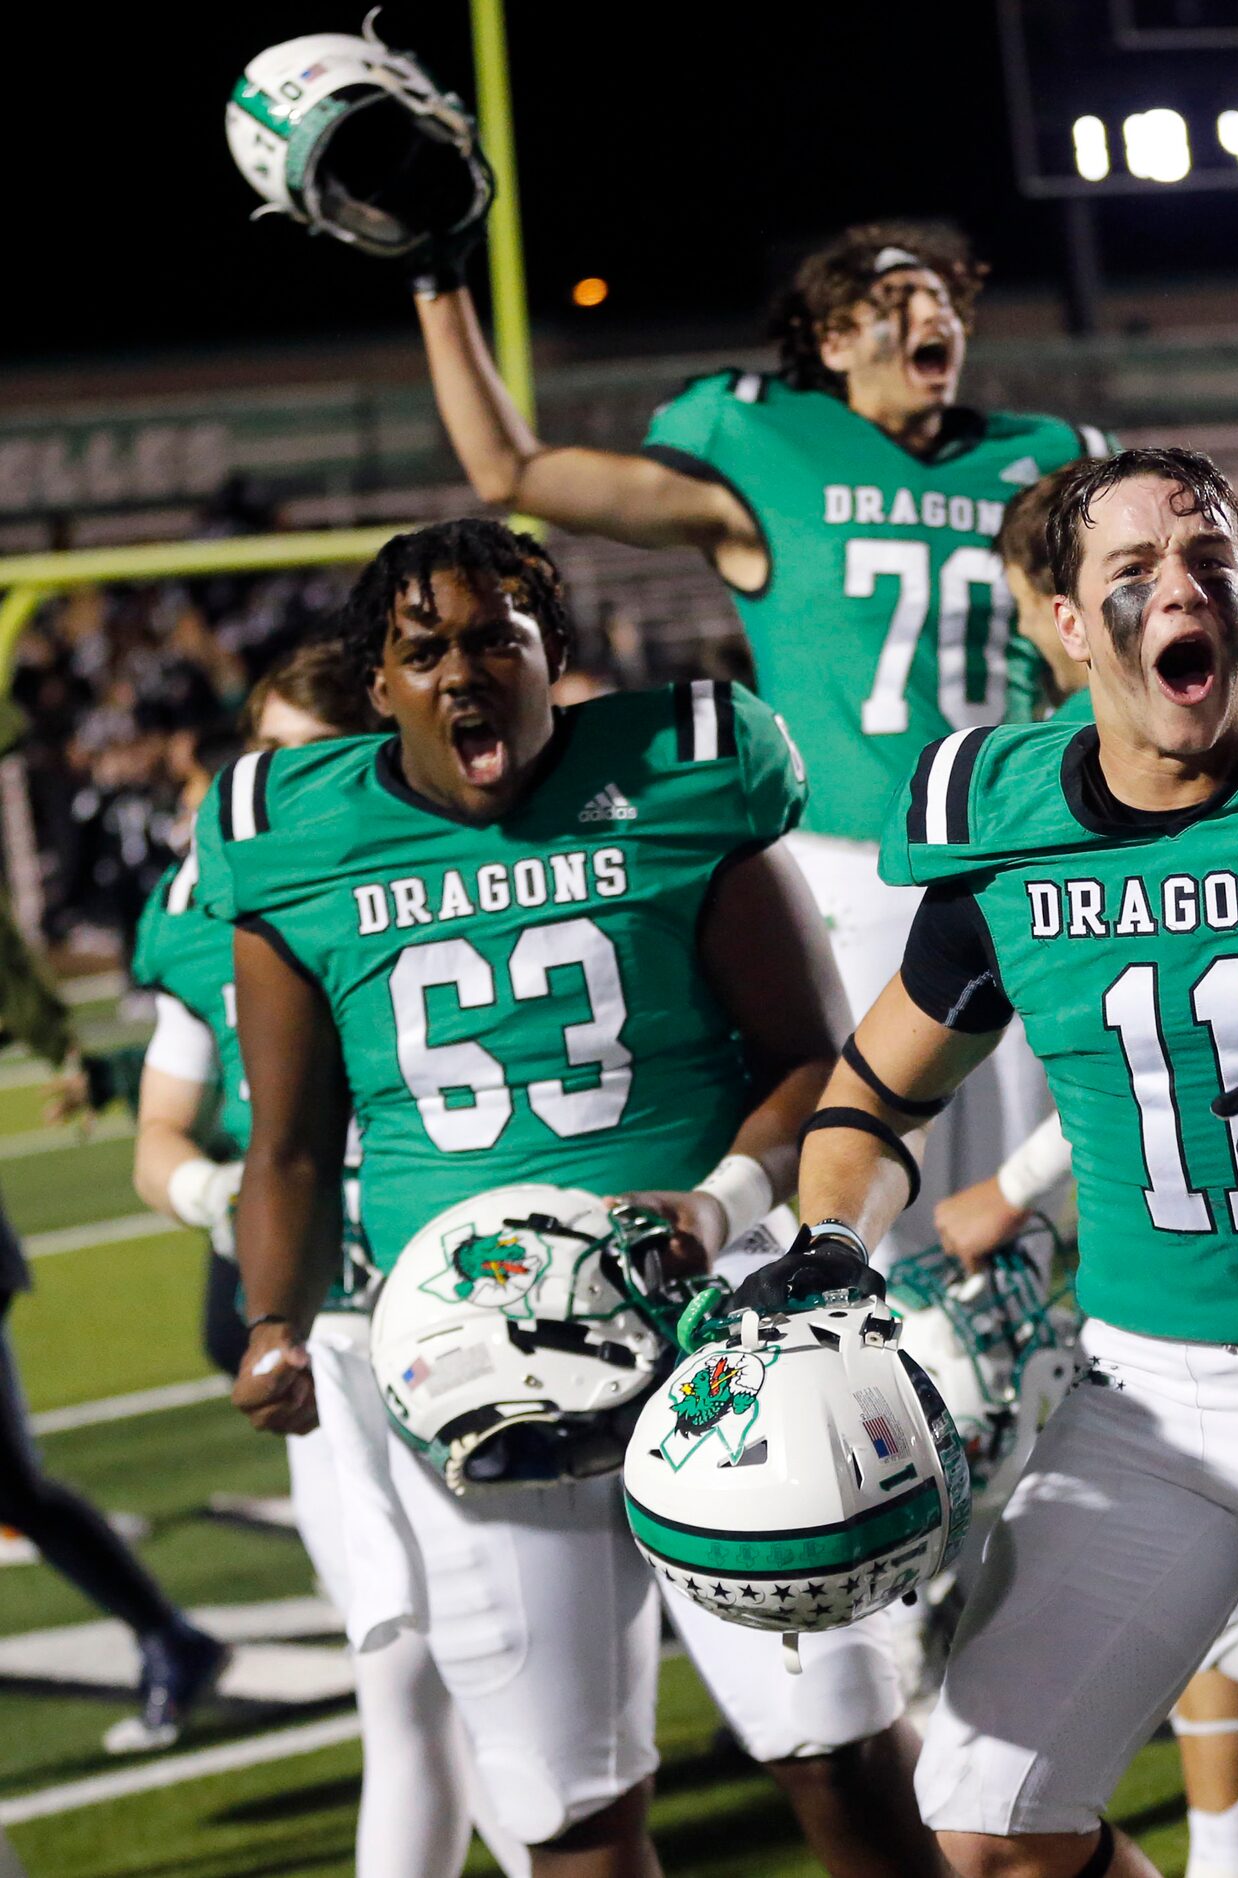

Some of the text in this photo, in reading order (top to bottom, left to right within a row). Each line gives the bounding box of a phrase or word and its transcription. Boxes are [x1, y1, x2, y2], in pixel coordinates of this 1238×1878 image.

[844, 537, 1012, 735] 70
[578, 806, 638, 823] adidas
[353, 847, 627, 936] DRAGONS
[389, 916, 633, 1153] 63
